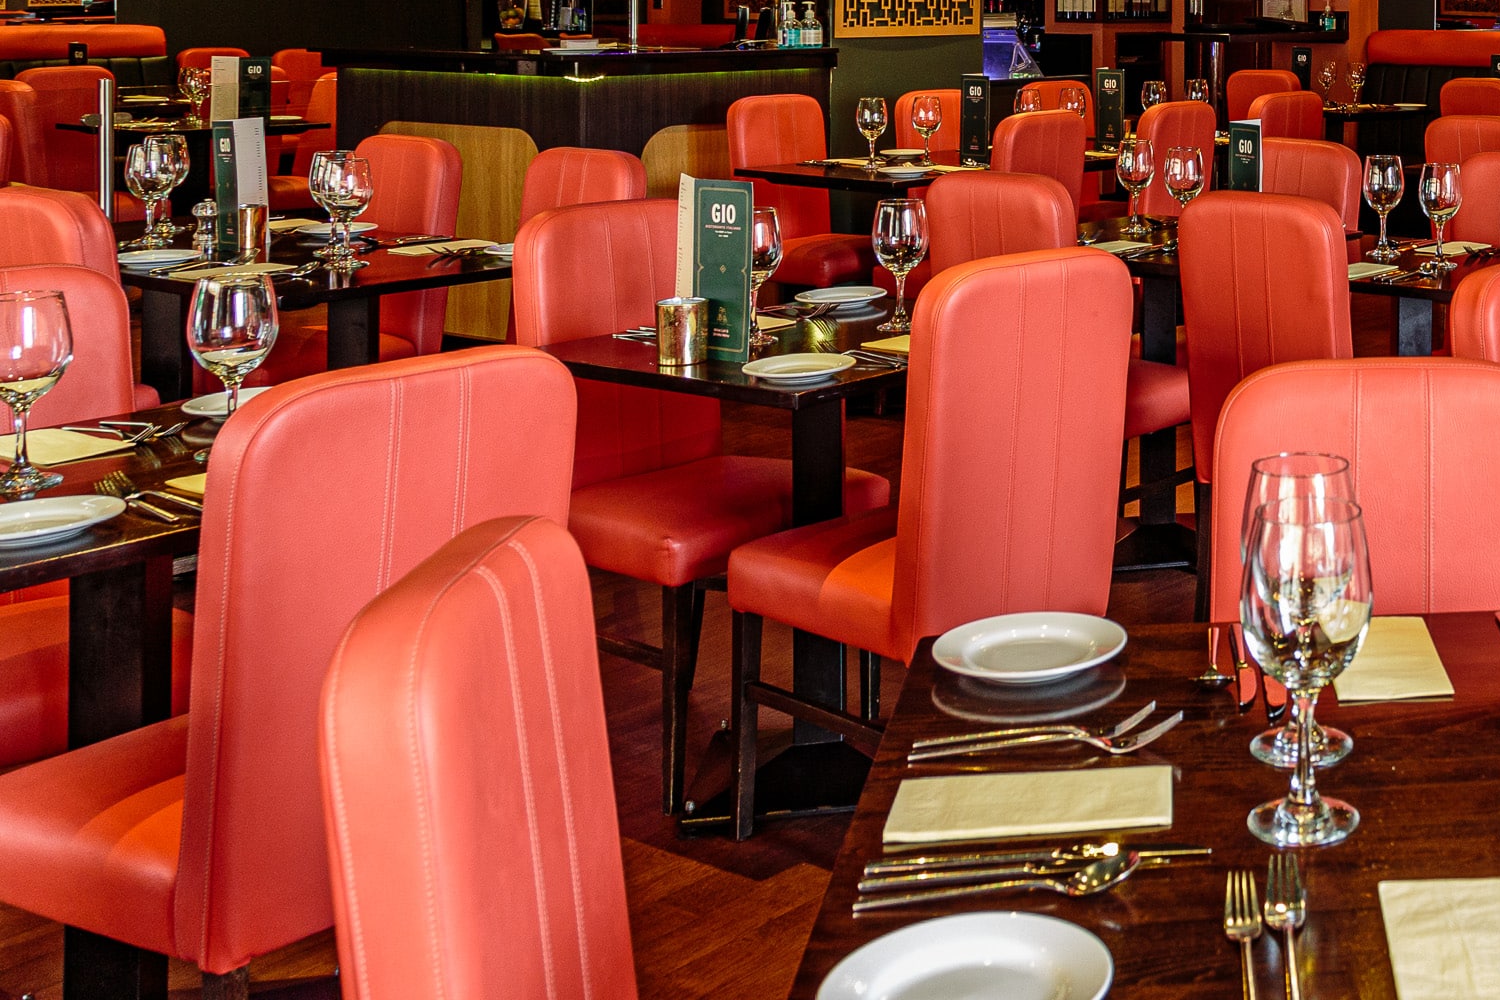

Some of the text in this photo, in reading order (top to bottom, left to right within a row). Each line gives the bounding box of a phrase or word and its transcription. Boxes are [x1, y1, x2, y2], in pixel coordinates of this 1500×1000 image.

[247, 65, 262, 74] GIO
[1104, 79, 1117, 89] GIO
[969, 86, 982, 97] GIO
[1238, 139, 1252, 154] GIO
[711, 203, 736, 224] GIO
